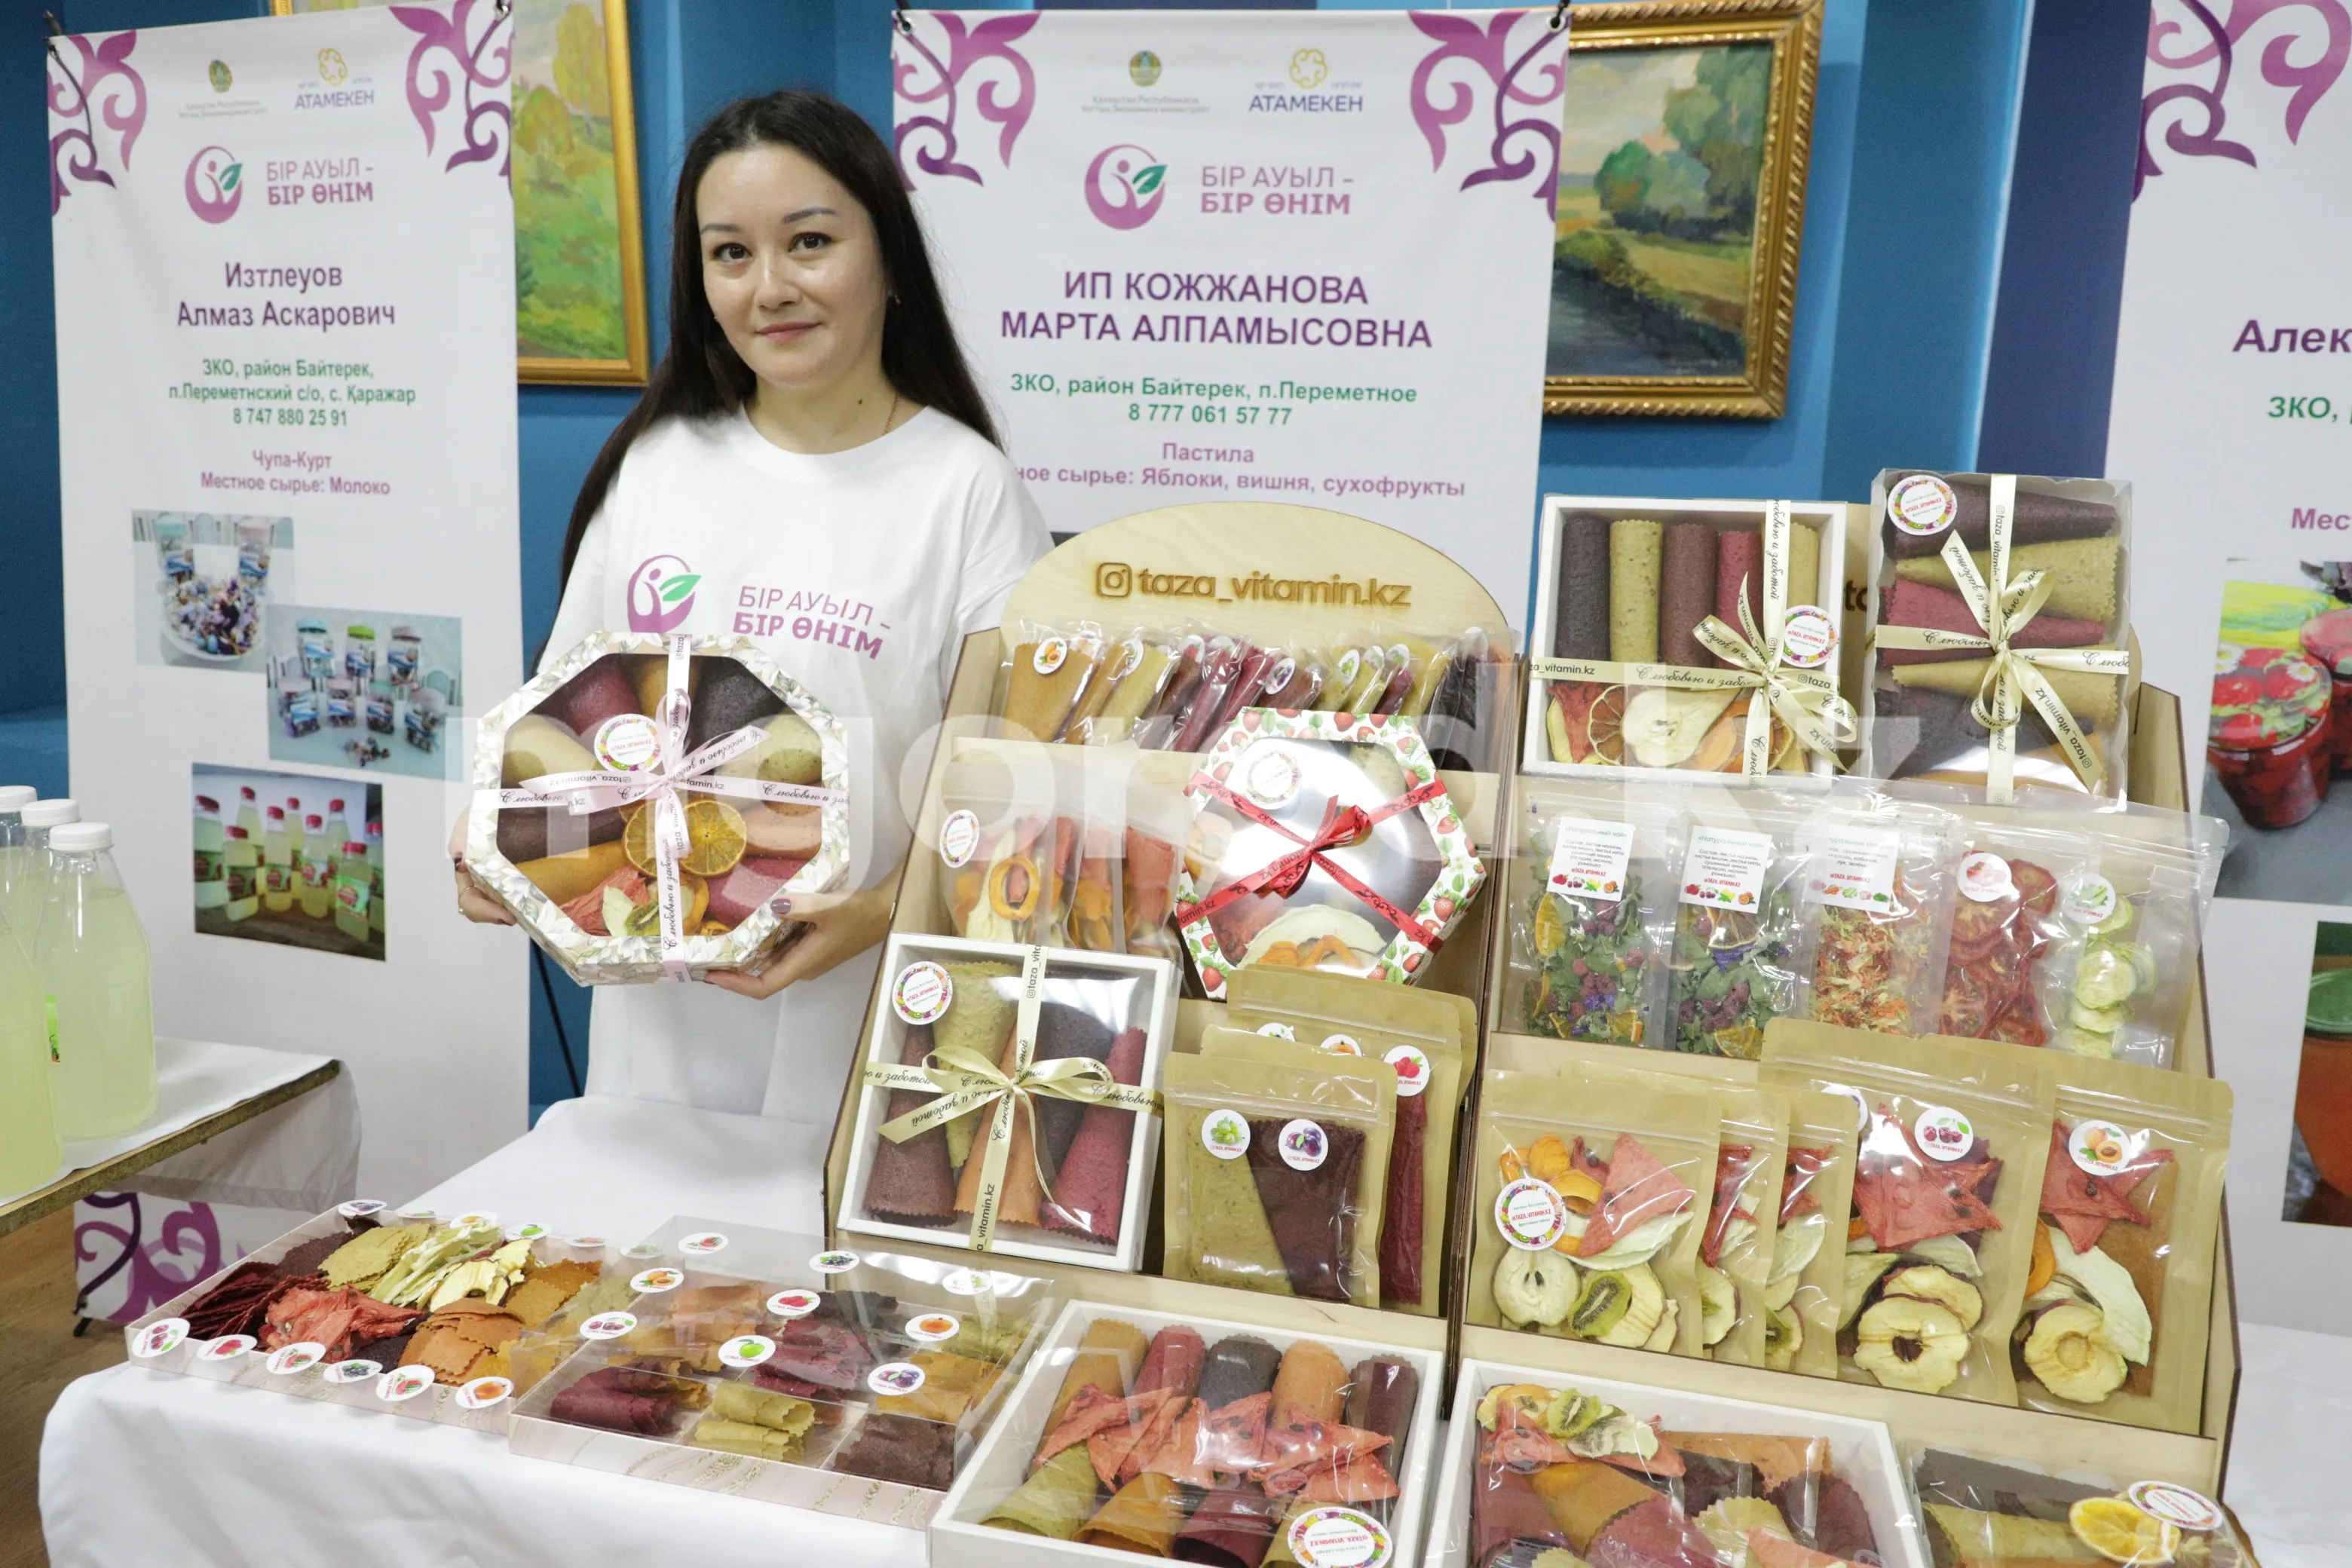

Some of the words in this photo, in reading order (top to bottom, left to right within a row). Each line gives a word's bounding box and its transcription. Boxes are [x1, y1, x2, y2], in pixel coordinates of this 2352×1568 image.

[294, 90, 375, 111] АТАМЕКЕН
[1248, 94, 1364, 113] АТАМЕКЕН
[266, 161, 298, 182] БІР
[302, 158, 360, 180] АУЫЛ
[1201, 166, 1246, 188] БІР
[1252, 166, 1334, 188] АУЫЛ
[268, 185, 305, 206] БІР
[312, 182, 374, 204] ӨНІМ
[1201, 192, 1254, 214] БІР
[1263, 192, 1351, 215] ӨНІМ
[225, 262, 343, 294] Изтлеуов
[1064, 270, 1113, 302] ИП
[1125, 272, 1370, 306] КОЖЖАНОВА
[177, 301, 254, 327] Алмаз
[262, 300, 396, 332] Аскарович
[1000, 311, 1121, 342] МАРТА
[1132, 314, 1433, 349] АЛПАМЫСОВНА
[243, 360, 291, 380] район
[296, 359, 375, 380] Байтерек,
[1010, 373, 1061, 396] ЗКО,
[1067, 375, 1135, 398] район
[1141, 377, 1251, 402] Байтерек,
[1258, 381, 1417, 405] п.Переметное
[233, 408, 242, 424] 8
[247, 408, 273, 425] 747
[277, 408, 305, 426] 880
[309, 409, 327, 426] 25
[330, 409, 348, 427] 91
[1129, 403, 1141, 422] 8
[1147, 404, 1184, 423] 777
[1191, 406, 1227, 424] 061
[1236, 406, 1261, 424] 57
[1267, 408, 1293, 425] 77
[2267, 395, 2339, 423] ЗКО,
[252, 450, 332, 473] Чупа-Курт
[1162, 443, 1255, 464] Пастила
[201, 472, 265, 492] Местное
[329, 476, 390, 495] Молоко
[1057, 468, 1135, 488] сырье:
[1141, 468, 1230, 492] Яблоки,
[1236, 474, 1315, 495] вишня,
[1322, 476, 1465, 499] сухофрукты
[1138, 568, 1412, 609] taza_vitamin.kz
[738, 585, 783, 611] БІР
[785, 589, 874, 627] АУЫЛ
[732, 611, 785, 639] БІР
[792, 621, 884, 660] ӨНІМ
